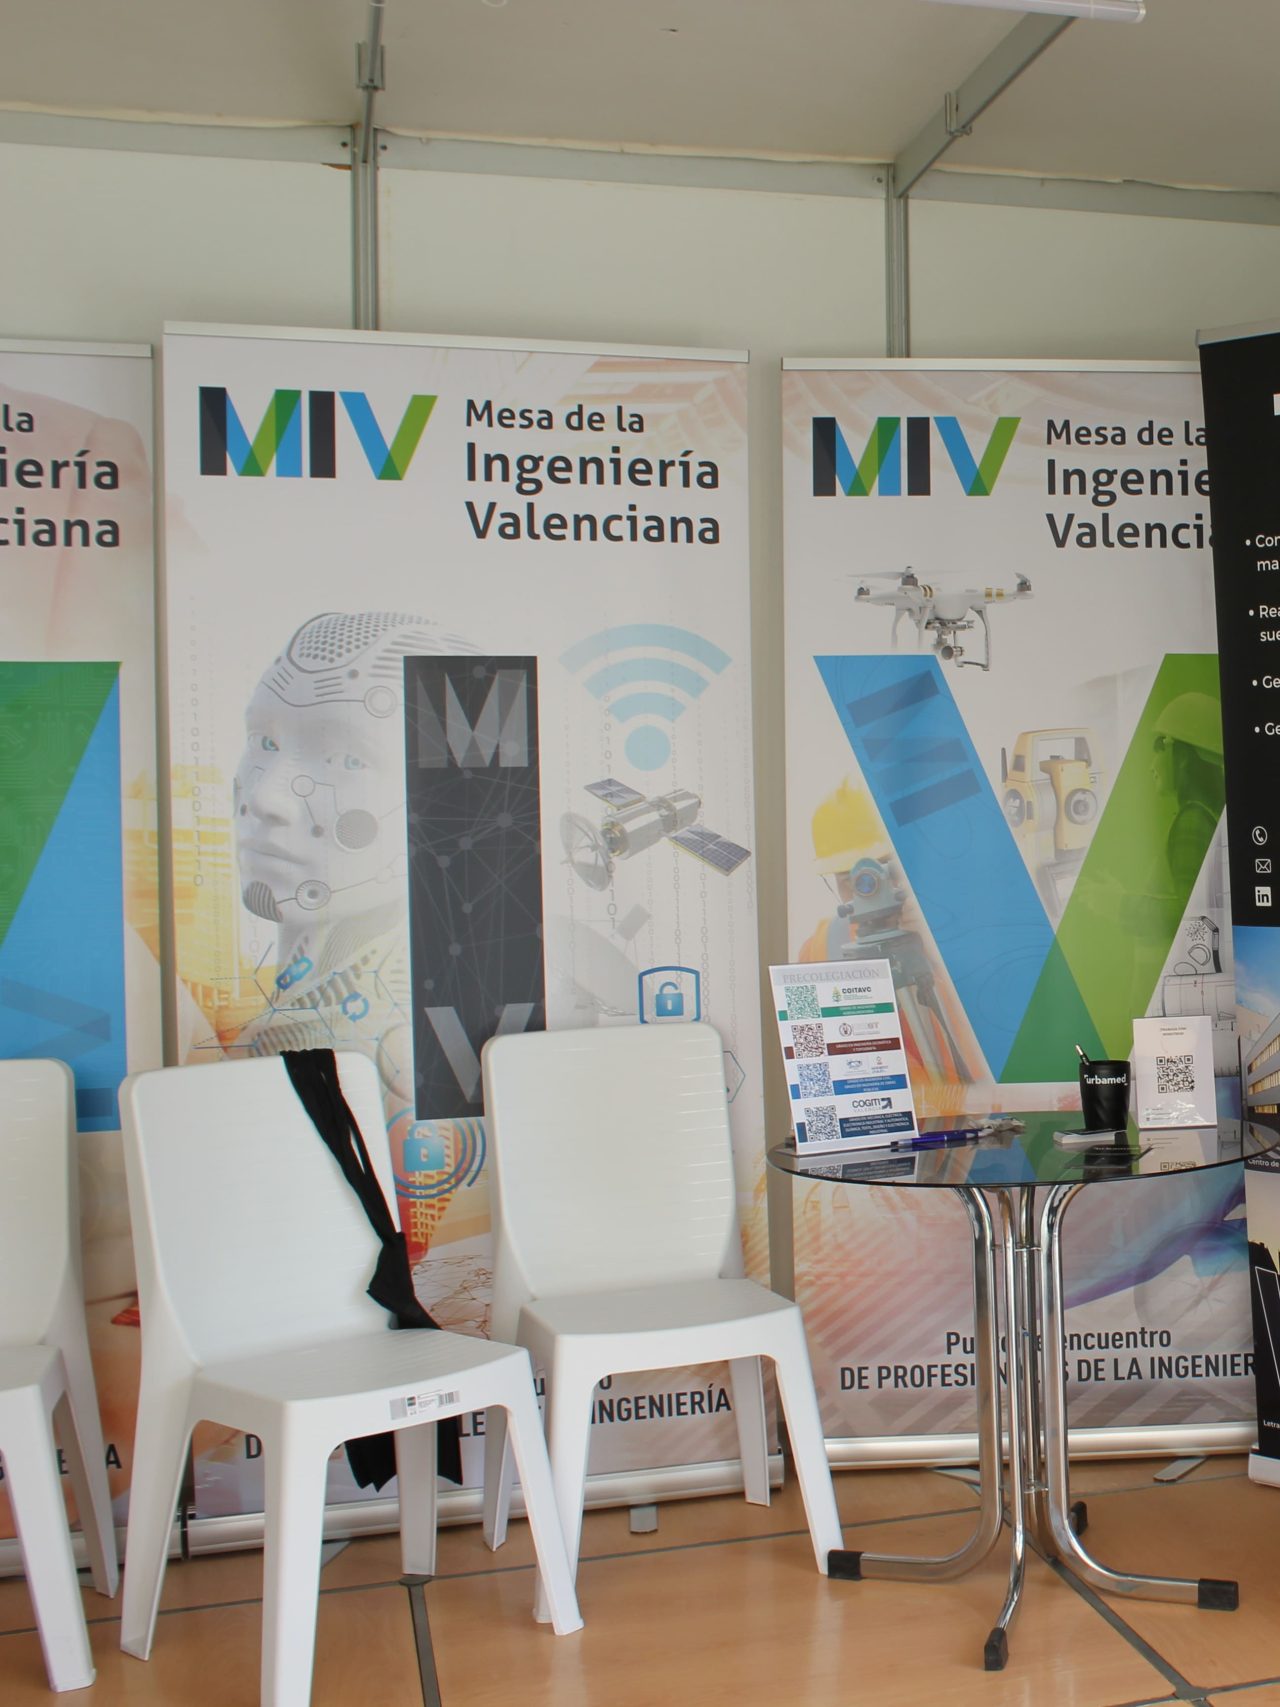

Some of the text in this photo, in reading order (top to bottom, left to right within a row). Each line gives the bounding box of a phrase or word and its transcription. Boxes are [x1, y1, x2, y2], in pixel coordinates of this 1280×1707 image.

[2, 403, 35, 433] la
[199, 386, 438, 481] MIV
[466, 399, 646, 434] Mesa de la
[1046, 419, 1207, 446] Mesa de la
[465, 441, 721, 495] Ingeniería
[812, 416, 1022, 497] MIV
[464, 501, 721, 545] Valenciana
[1045, 512, 1214, 549] Valenci
[1085, 1073, 1128, 1086] urbamed
[840, 1366, 869, 1391] DE
[1076, 1358, 1106, 1383] DE
[1113, 1356, 1144, 1381] LA
[590, 1382, 733, 1425] INGENIERÍA
